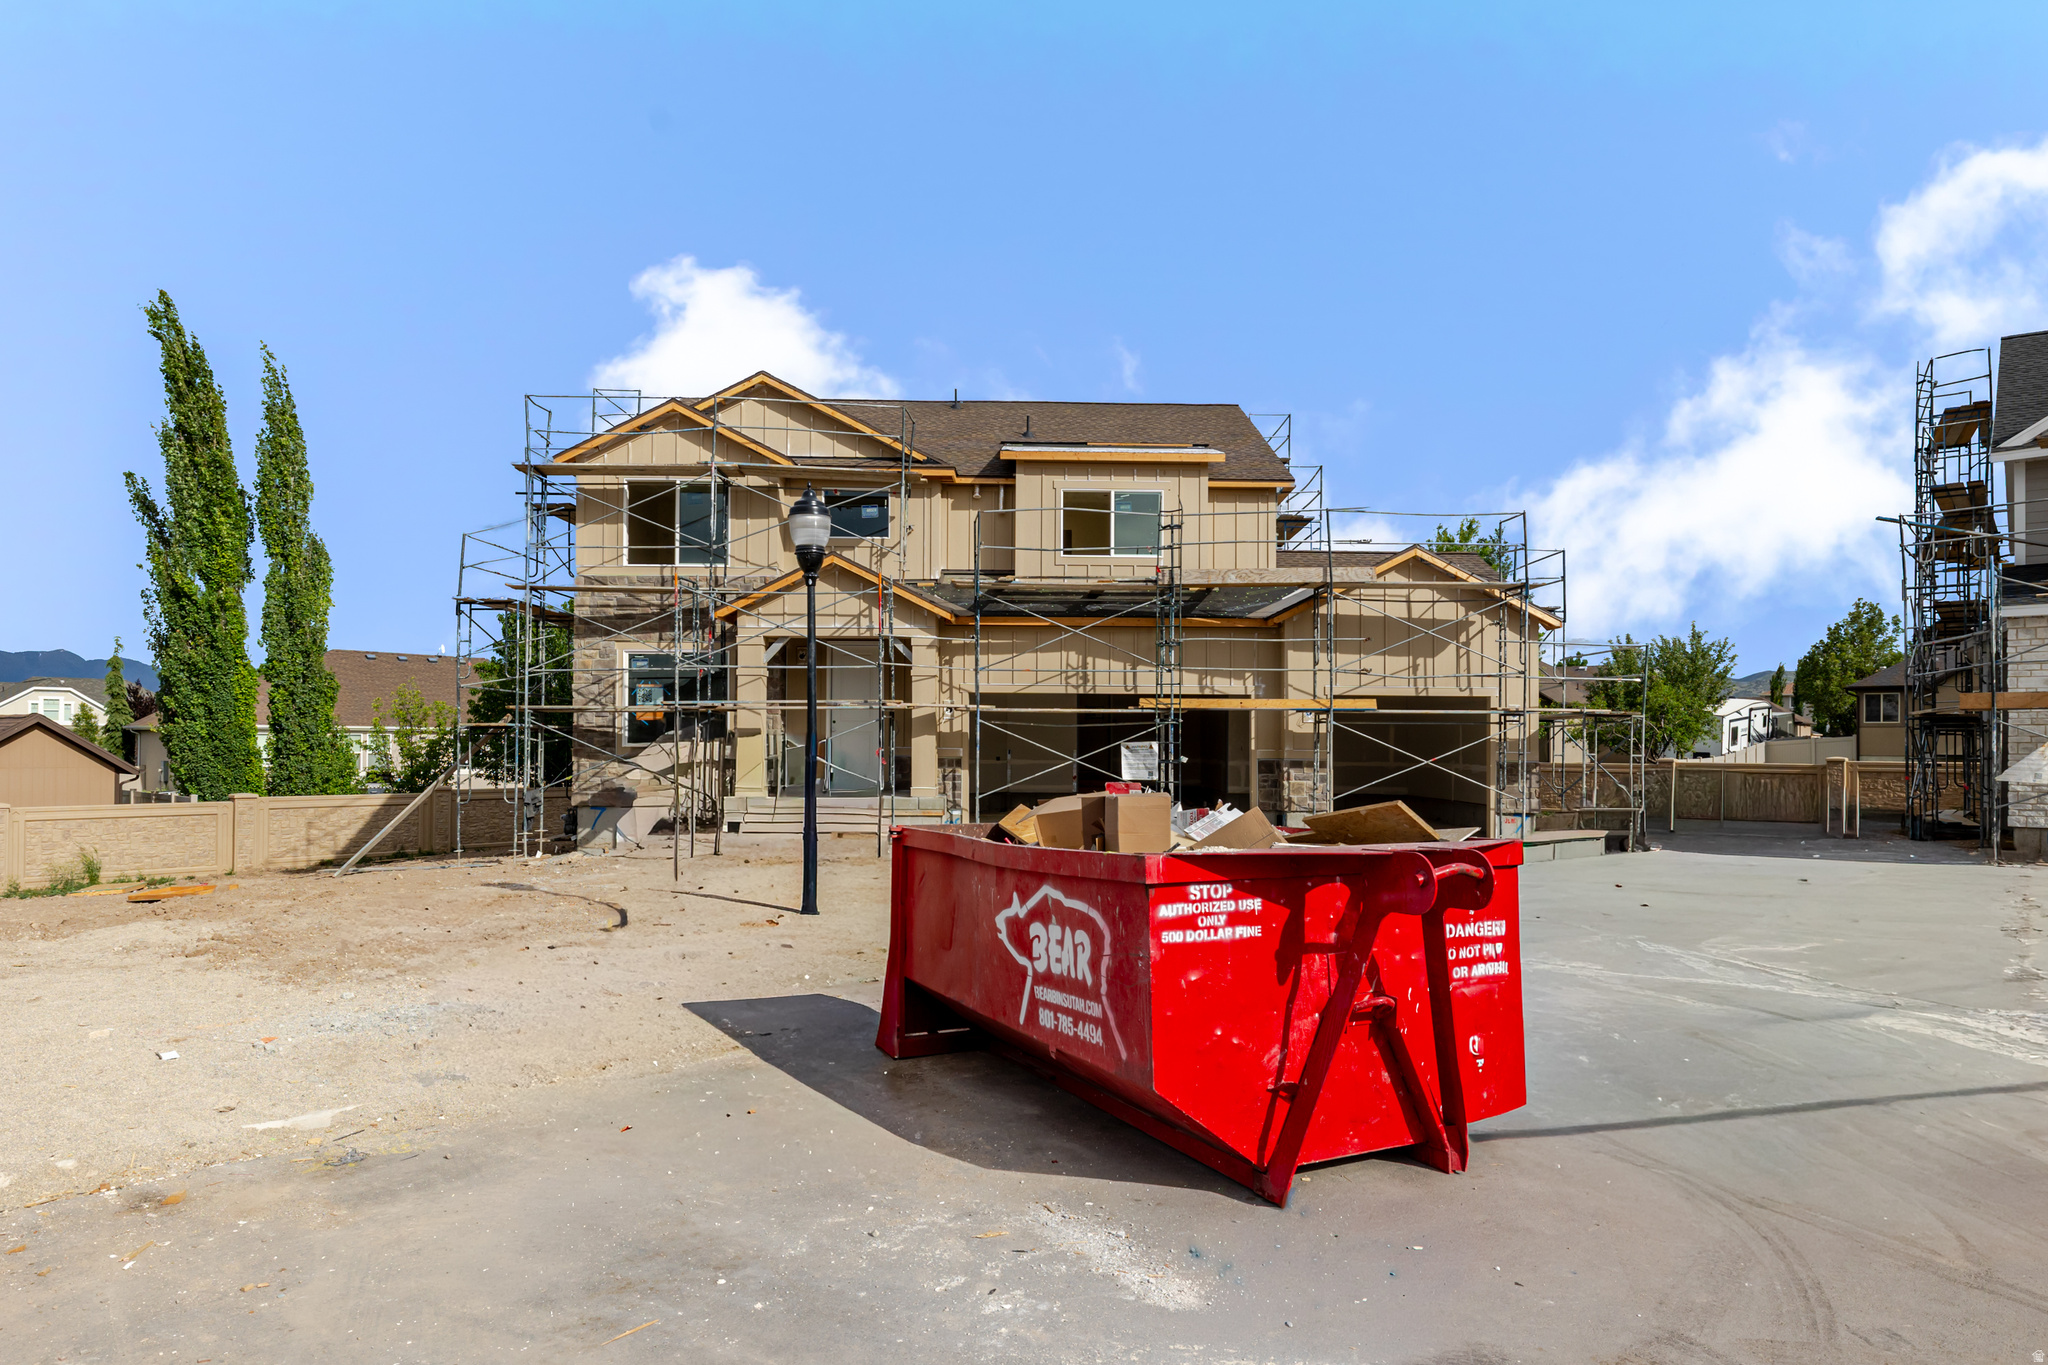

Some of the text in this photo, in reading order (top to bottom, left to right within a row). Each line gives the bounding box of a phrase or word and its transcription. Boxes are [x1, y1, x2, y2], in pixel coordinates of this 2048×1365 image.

[590, 807, 606, 830] 7
[1189, 883, 1233, 900] STOP
[1159, 898, 1262, 917] AUTHORIZED USE
[1197, 914, 1227, 927] ONLY
[1161, 925, 1262, 943] 500 DOLLAR FINE
[1029, 921, 1092, 987] BEAR
[1459, 944, 1481, 959] NOT
[1452, 966, 1469, 979] OR
[1033, 985, 1103, 1019] BEARBINSUTAH.COM
[1038, 1007, 1103, 1047] 801-785-4494
